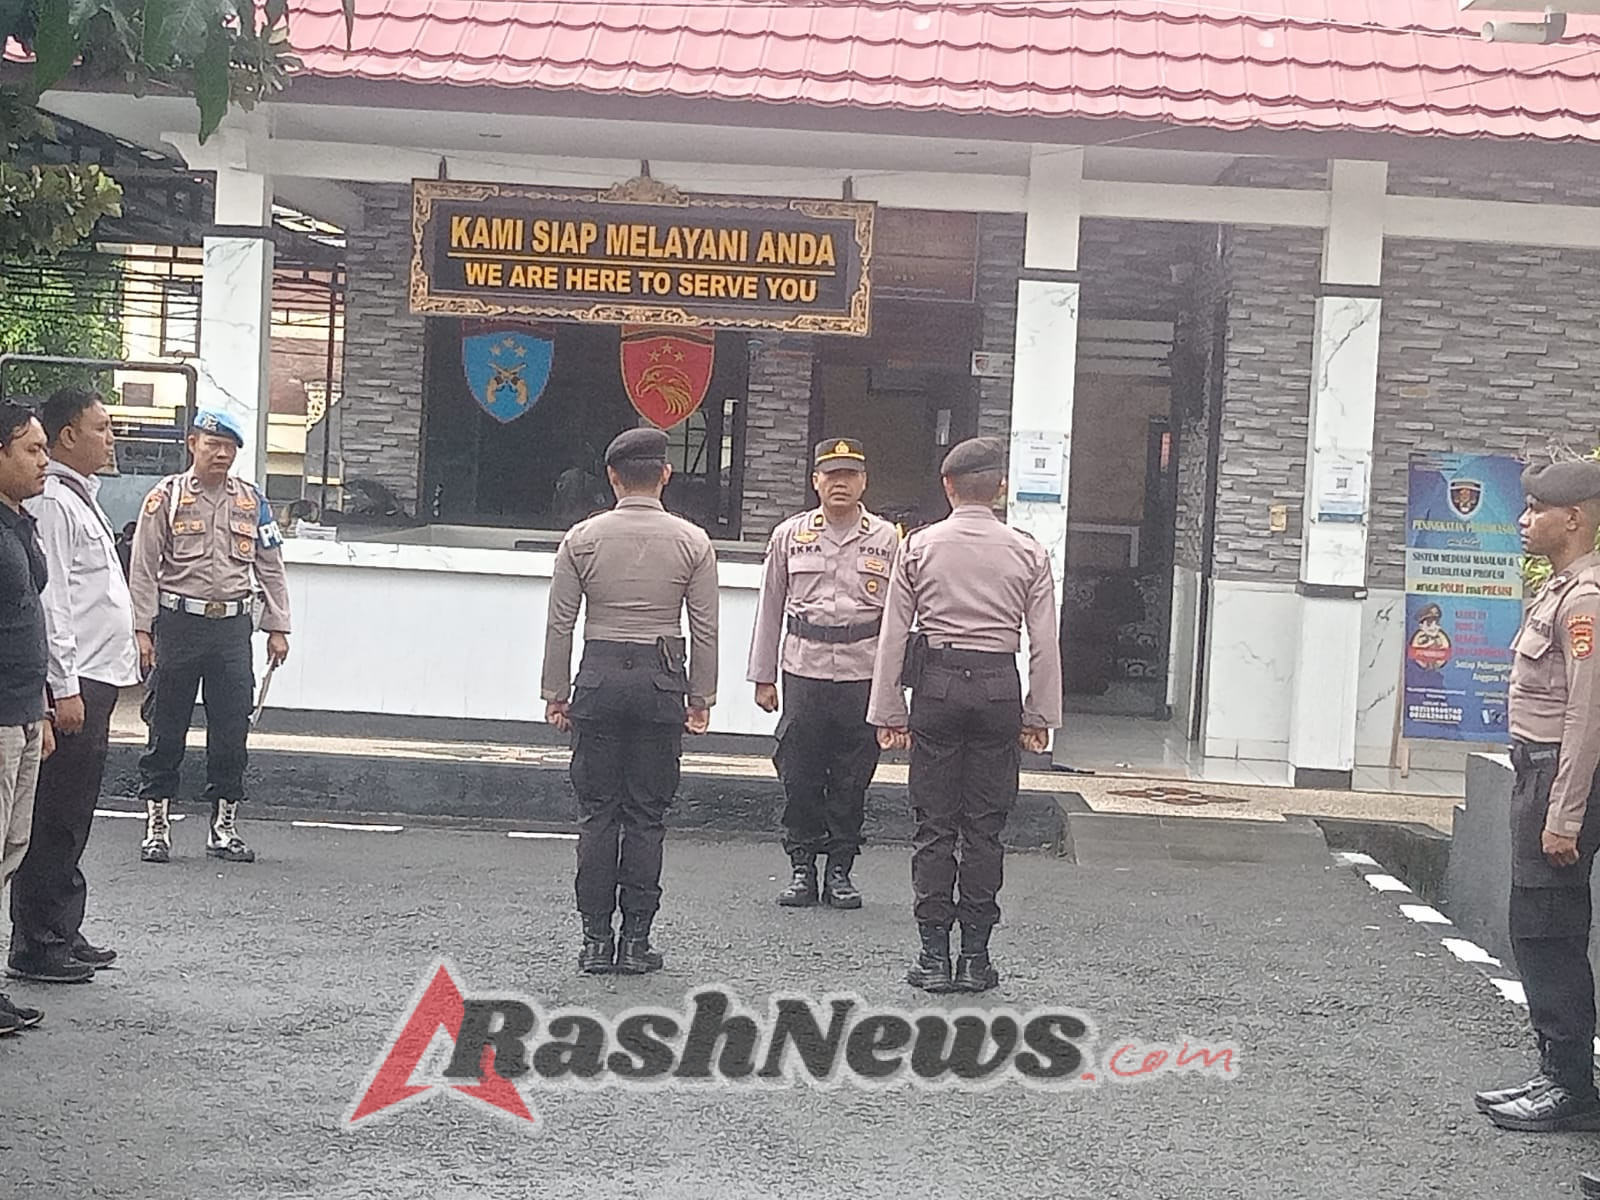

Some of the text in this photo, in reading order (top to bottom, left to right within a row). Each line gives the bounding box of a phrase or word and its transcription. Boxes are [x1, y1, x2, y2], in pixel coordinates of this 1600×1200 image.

[450, 215, 835, 267] KAMI SIAP MELAYANI ANDA
[464, 262, 818, 303] WE ARE HERE TO SERVE YOU
[859, 546, 889, 558] POLRI
